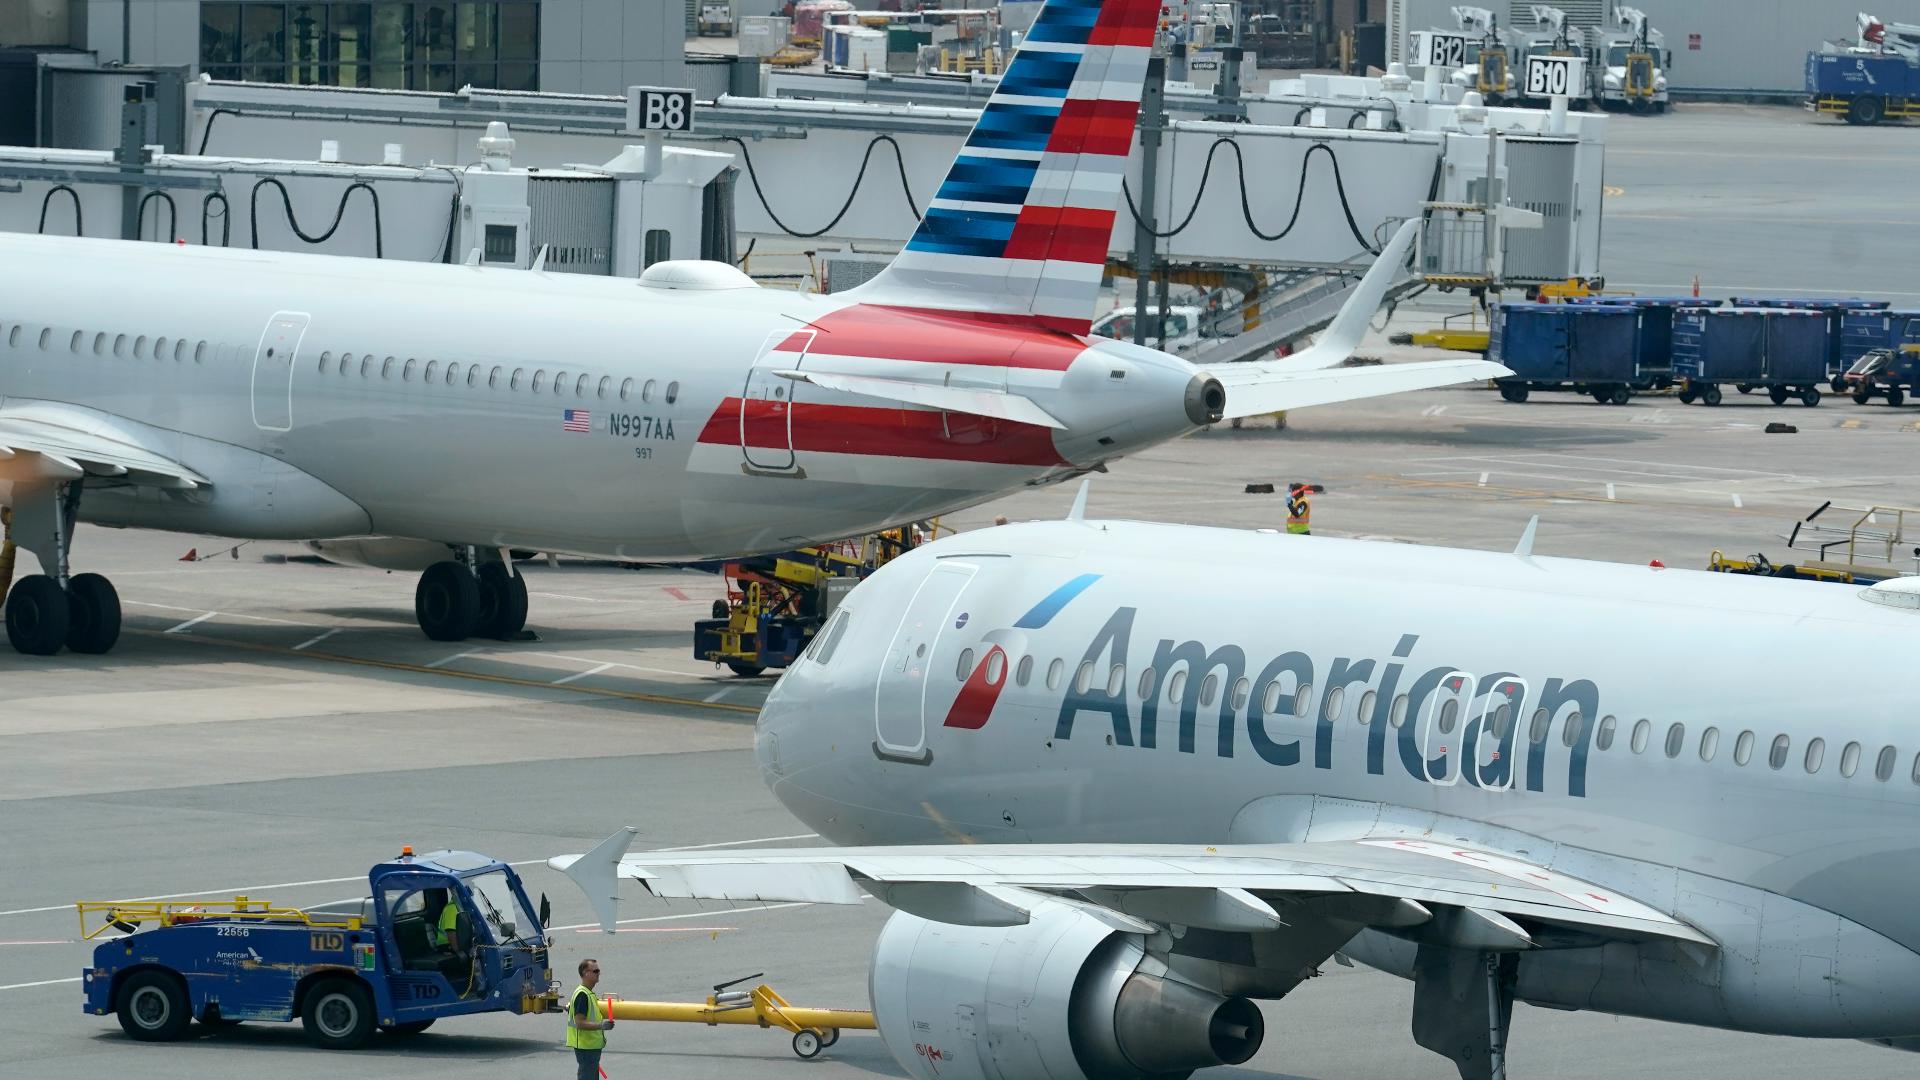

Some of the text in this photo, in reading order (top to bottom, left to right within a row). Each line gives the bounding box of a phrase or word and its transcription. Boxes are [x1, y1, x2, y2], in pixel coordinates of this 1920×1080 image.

[1433, 36, 1464, 66] B12
[1530, 61, 1566, 94] B10
[646, 93, 684, 129] B8
[610, 413, 675, 440] N997AA
[635, 447, 652, 459] 997
[1054, 606, 1599, 797] American
[312, 933, 342, 949] TLD
[216, 951, 248, 959] American
[413, 985, 440, 999] TLD
